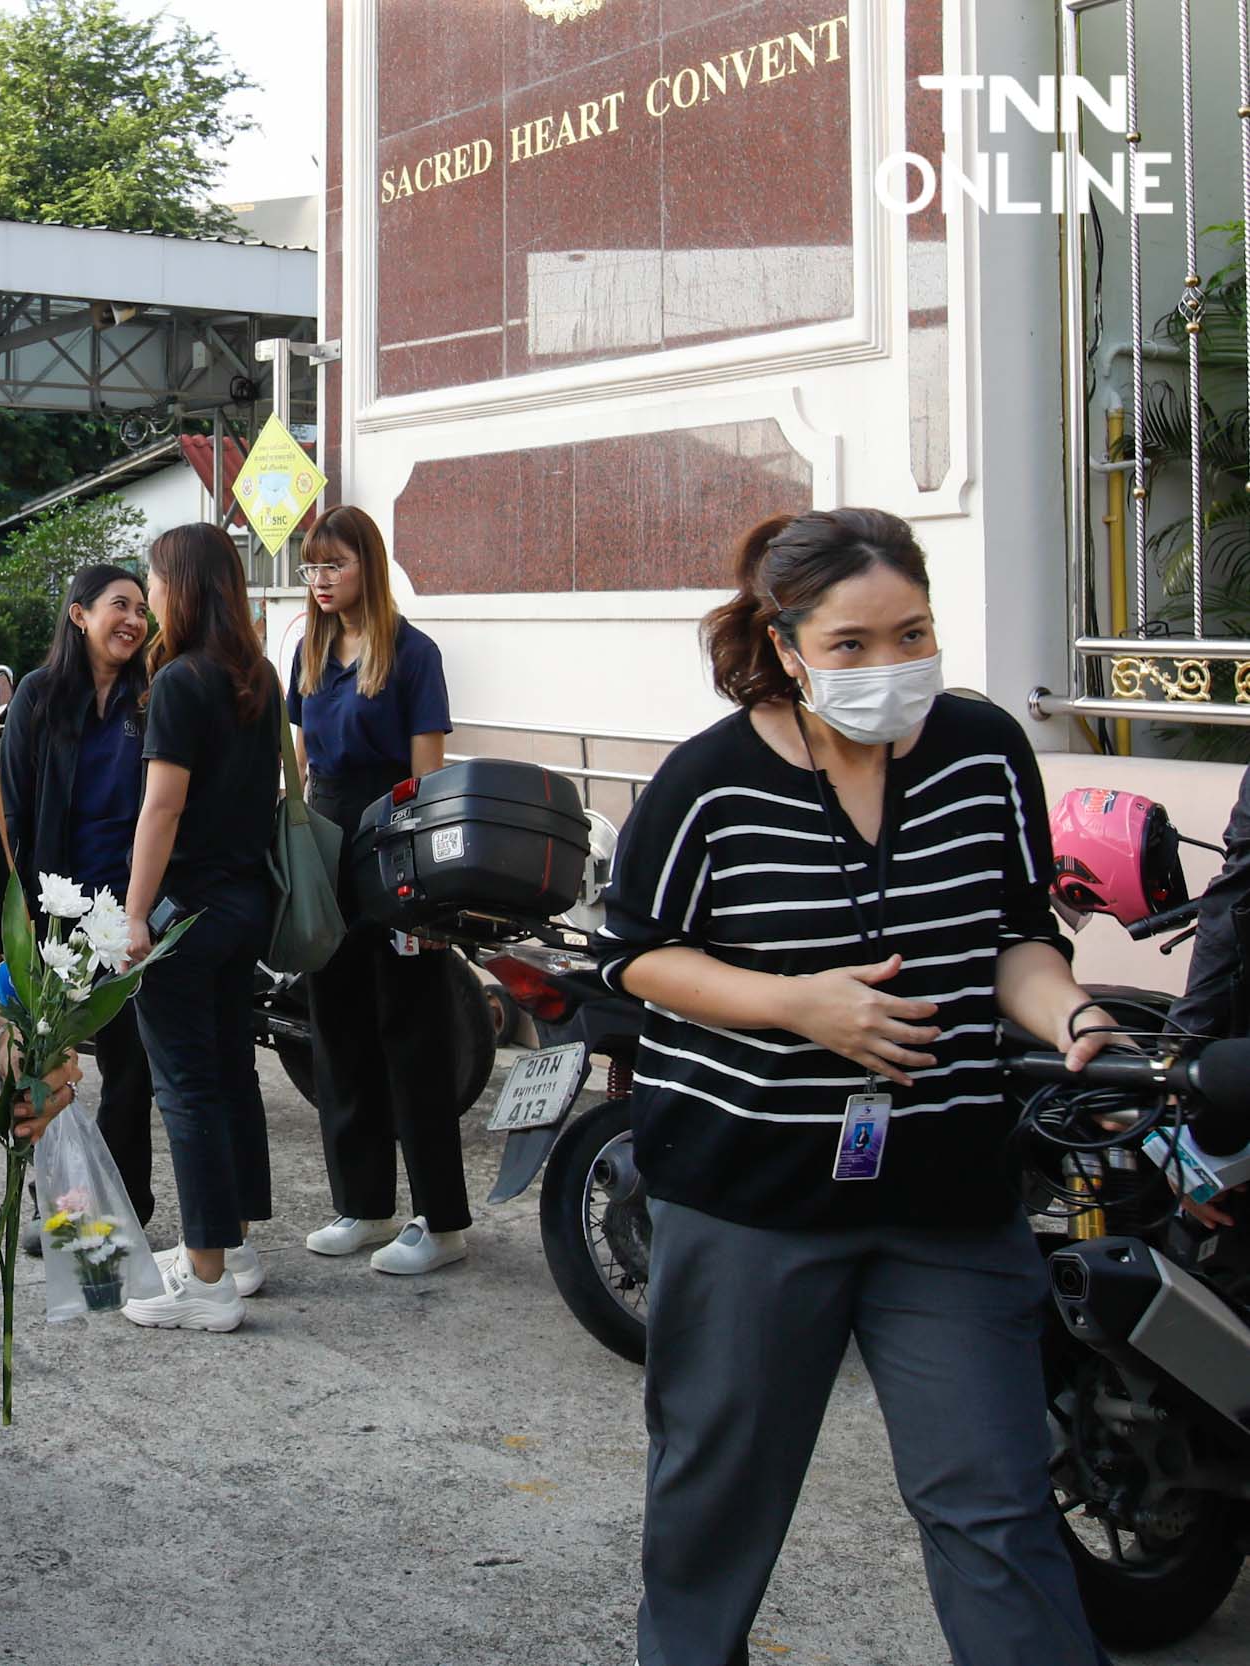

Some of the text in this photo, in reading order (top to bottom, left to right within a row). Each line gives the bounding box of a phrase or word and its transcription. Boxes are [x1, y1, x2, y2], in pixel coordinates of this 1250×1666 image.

[380, 15, 848, 204] SACRED HEART CONVENT
[508, 1099, 547, 1121] 413
